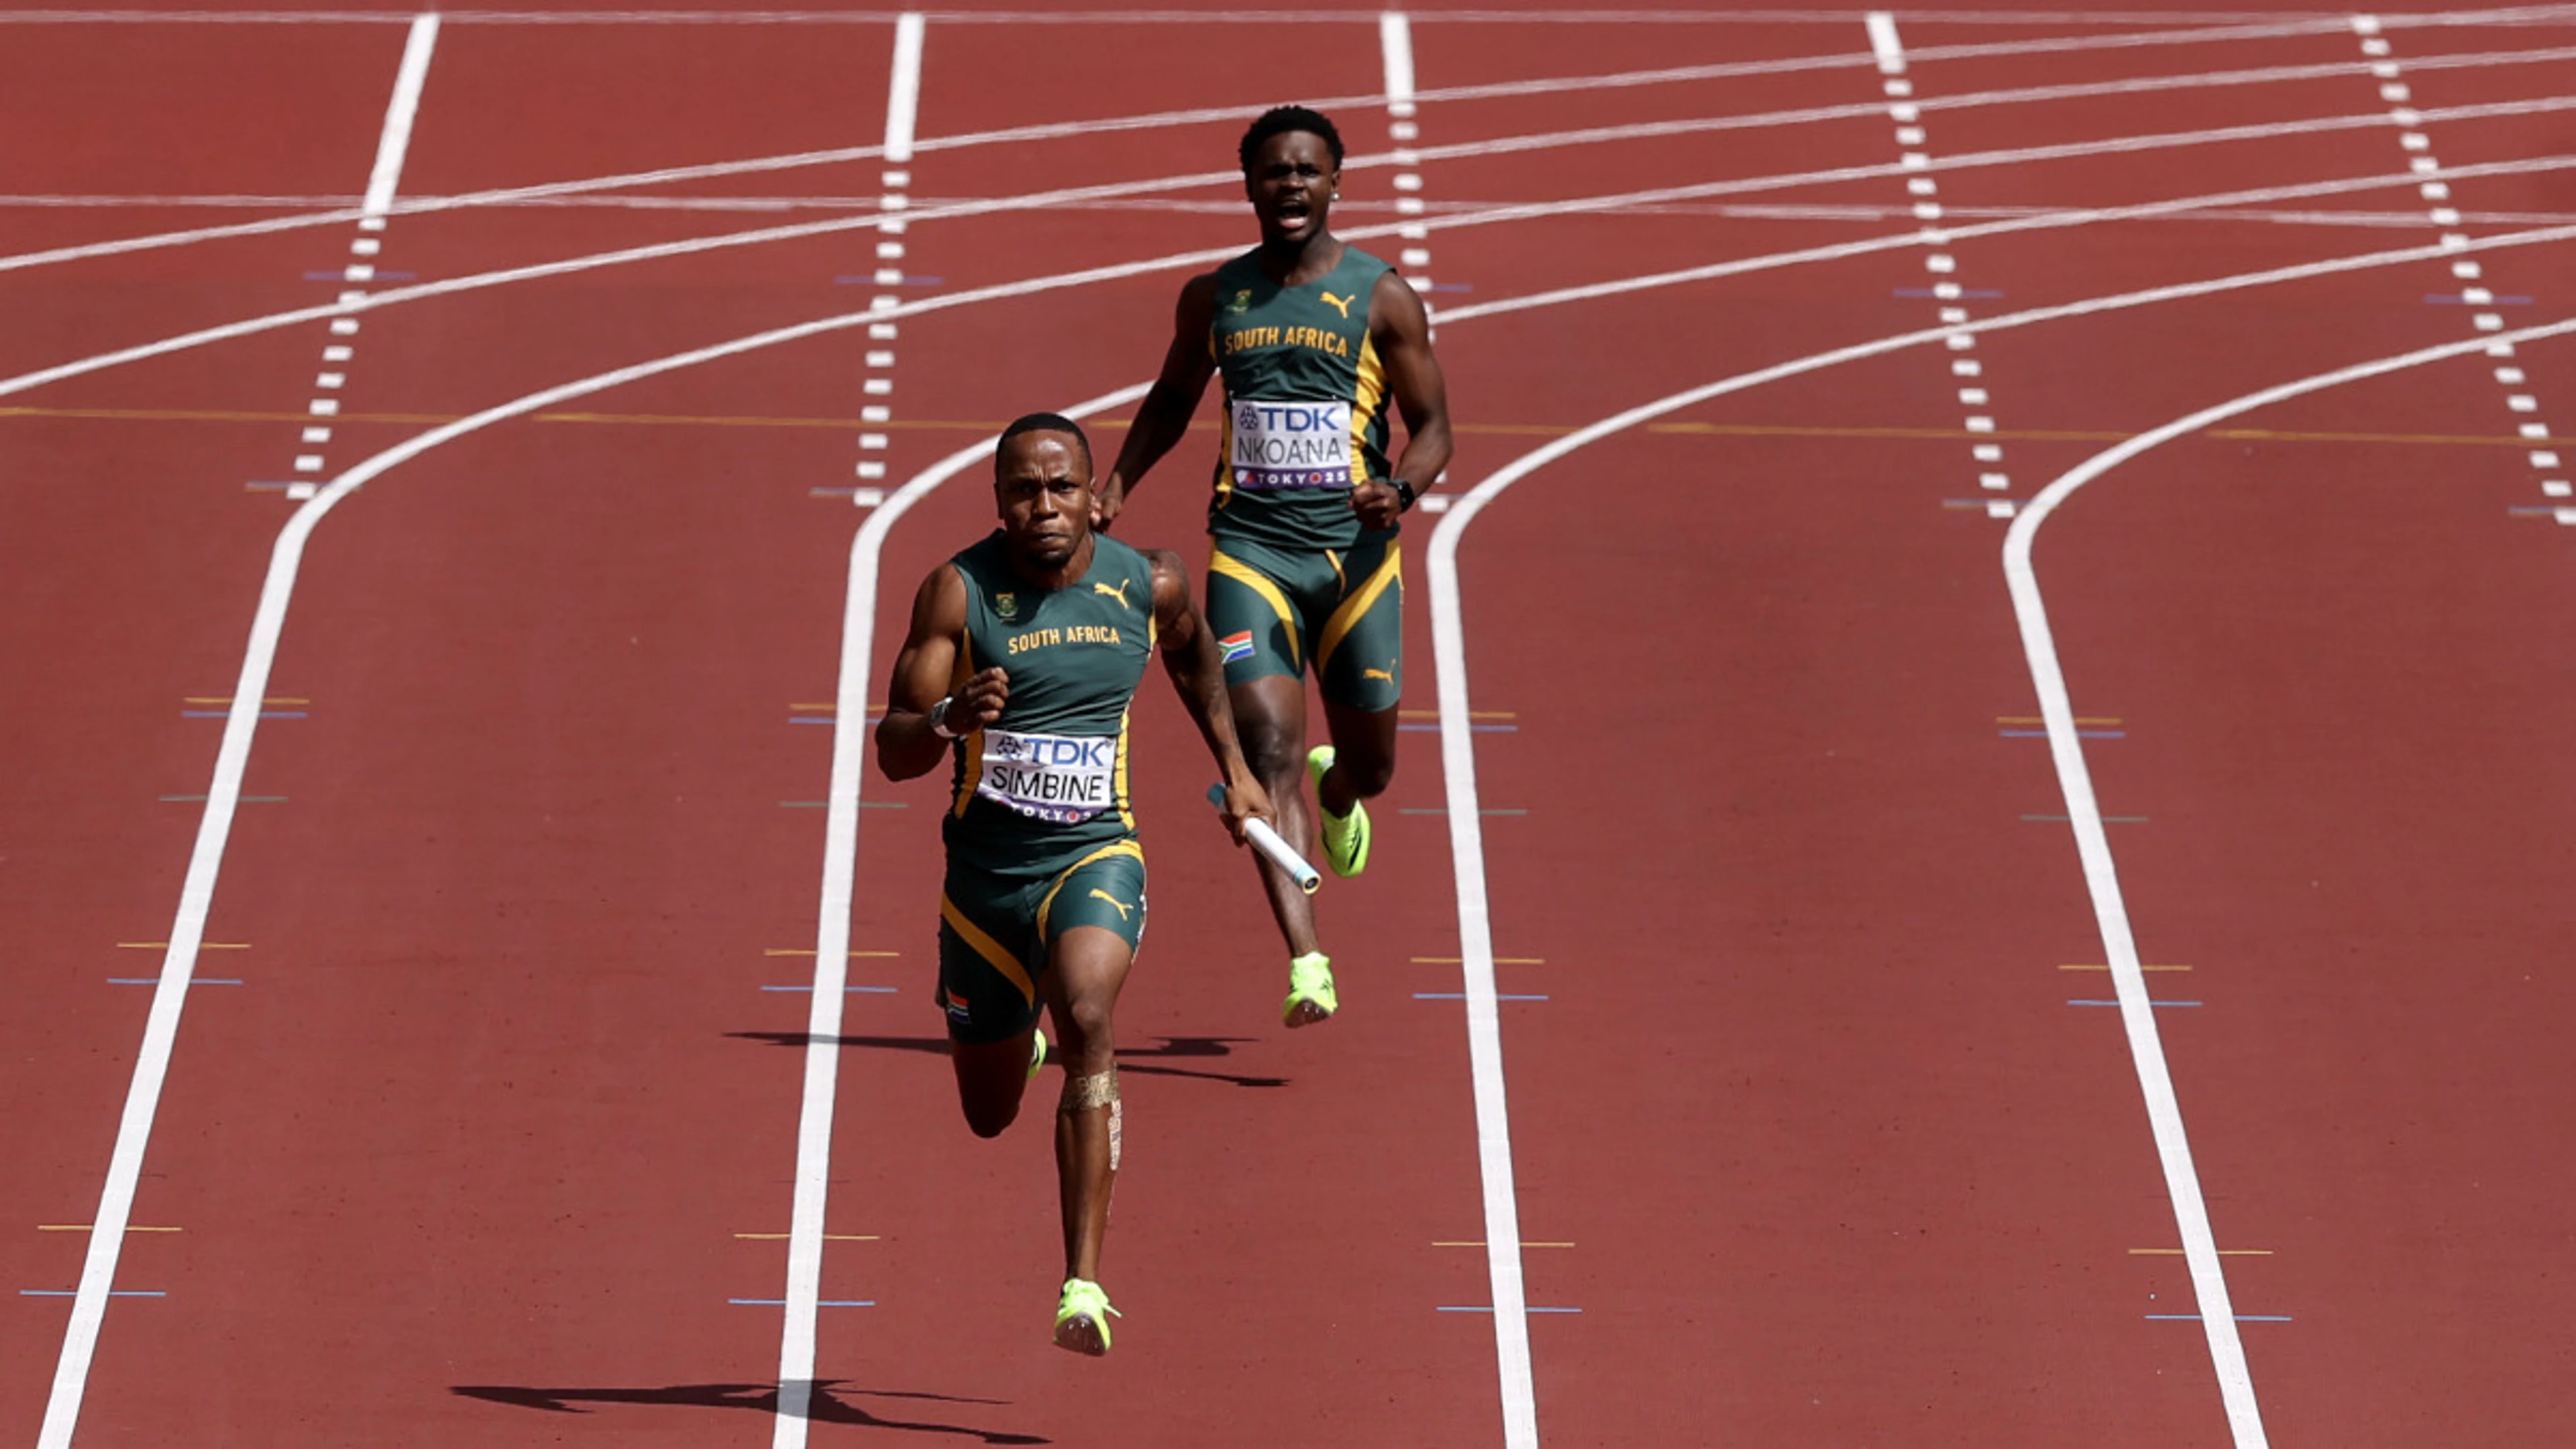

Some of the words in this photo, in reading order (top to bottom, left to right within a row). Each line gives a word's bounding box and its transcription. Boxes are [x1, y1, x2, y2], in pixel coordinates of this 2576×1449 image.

[1225, 327, 1279, 355] SOUTH
[1284, 327, 1347, 357] AFRICA
[1258, 408, 1338, 431] TDK
[1238, 437, 1342, 464] NKOANA
[1008, 629, 1061, 655] SOUTH
[1066, 626, 1121, 645] AFRICA
[1024, 738, 1104, 767] TDK
[991, 766, 1104, 801] SIMBINE
